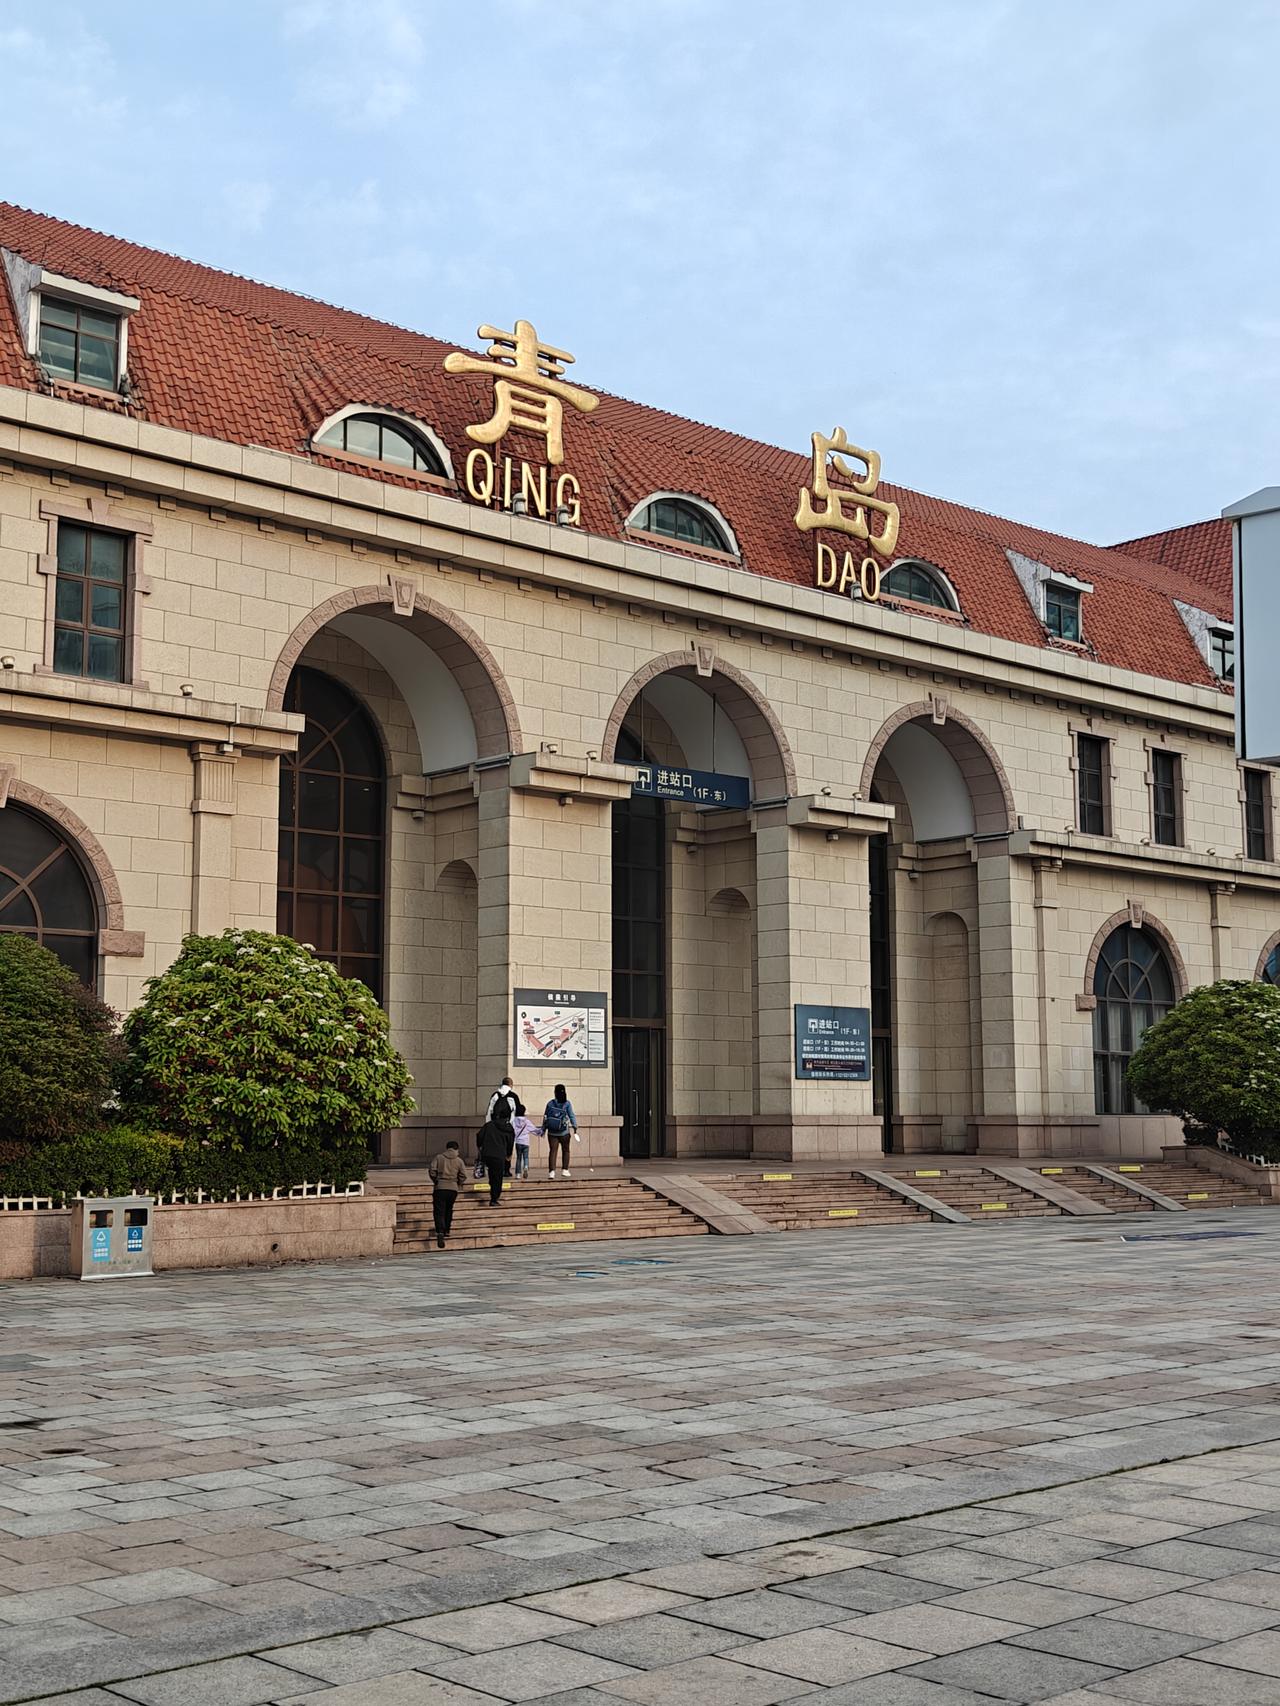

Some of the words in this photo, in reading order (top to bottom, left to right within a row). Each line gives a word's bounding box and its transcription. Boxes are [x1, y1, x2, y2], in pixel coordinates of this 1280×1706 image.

[443, 319, 599, 465] 青
[793, 426, 900, 556] 岛
[465, 448, 582, 526] QING
[817, 543, 881, 601] DAO
[657, 769, 692, 788] 进站口
[657, 785, 685, 796] Entrance
